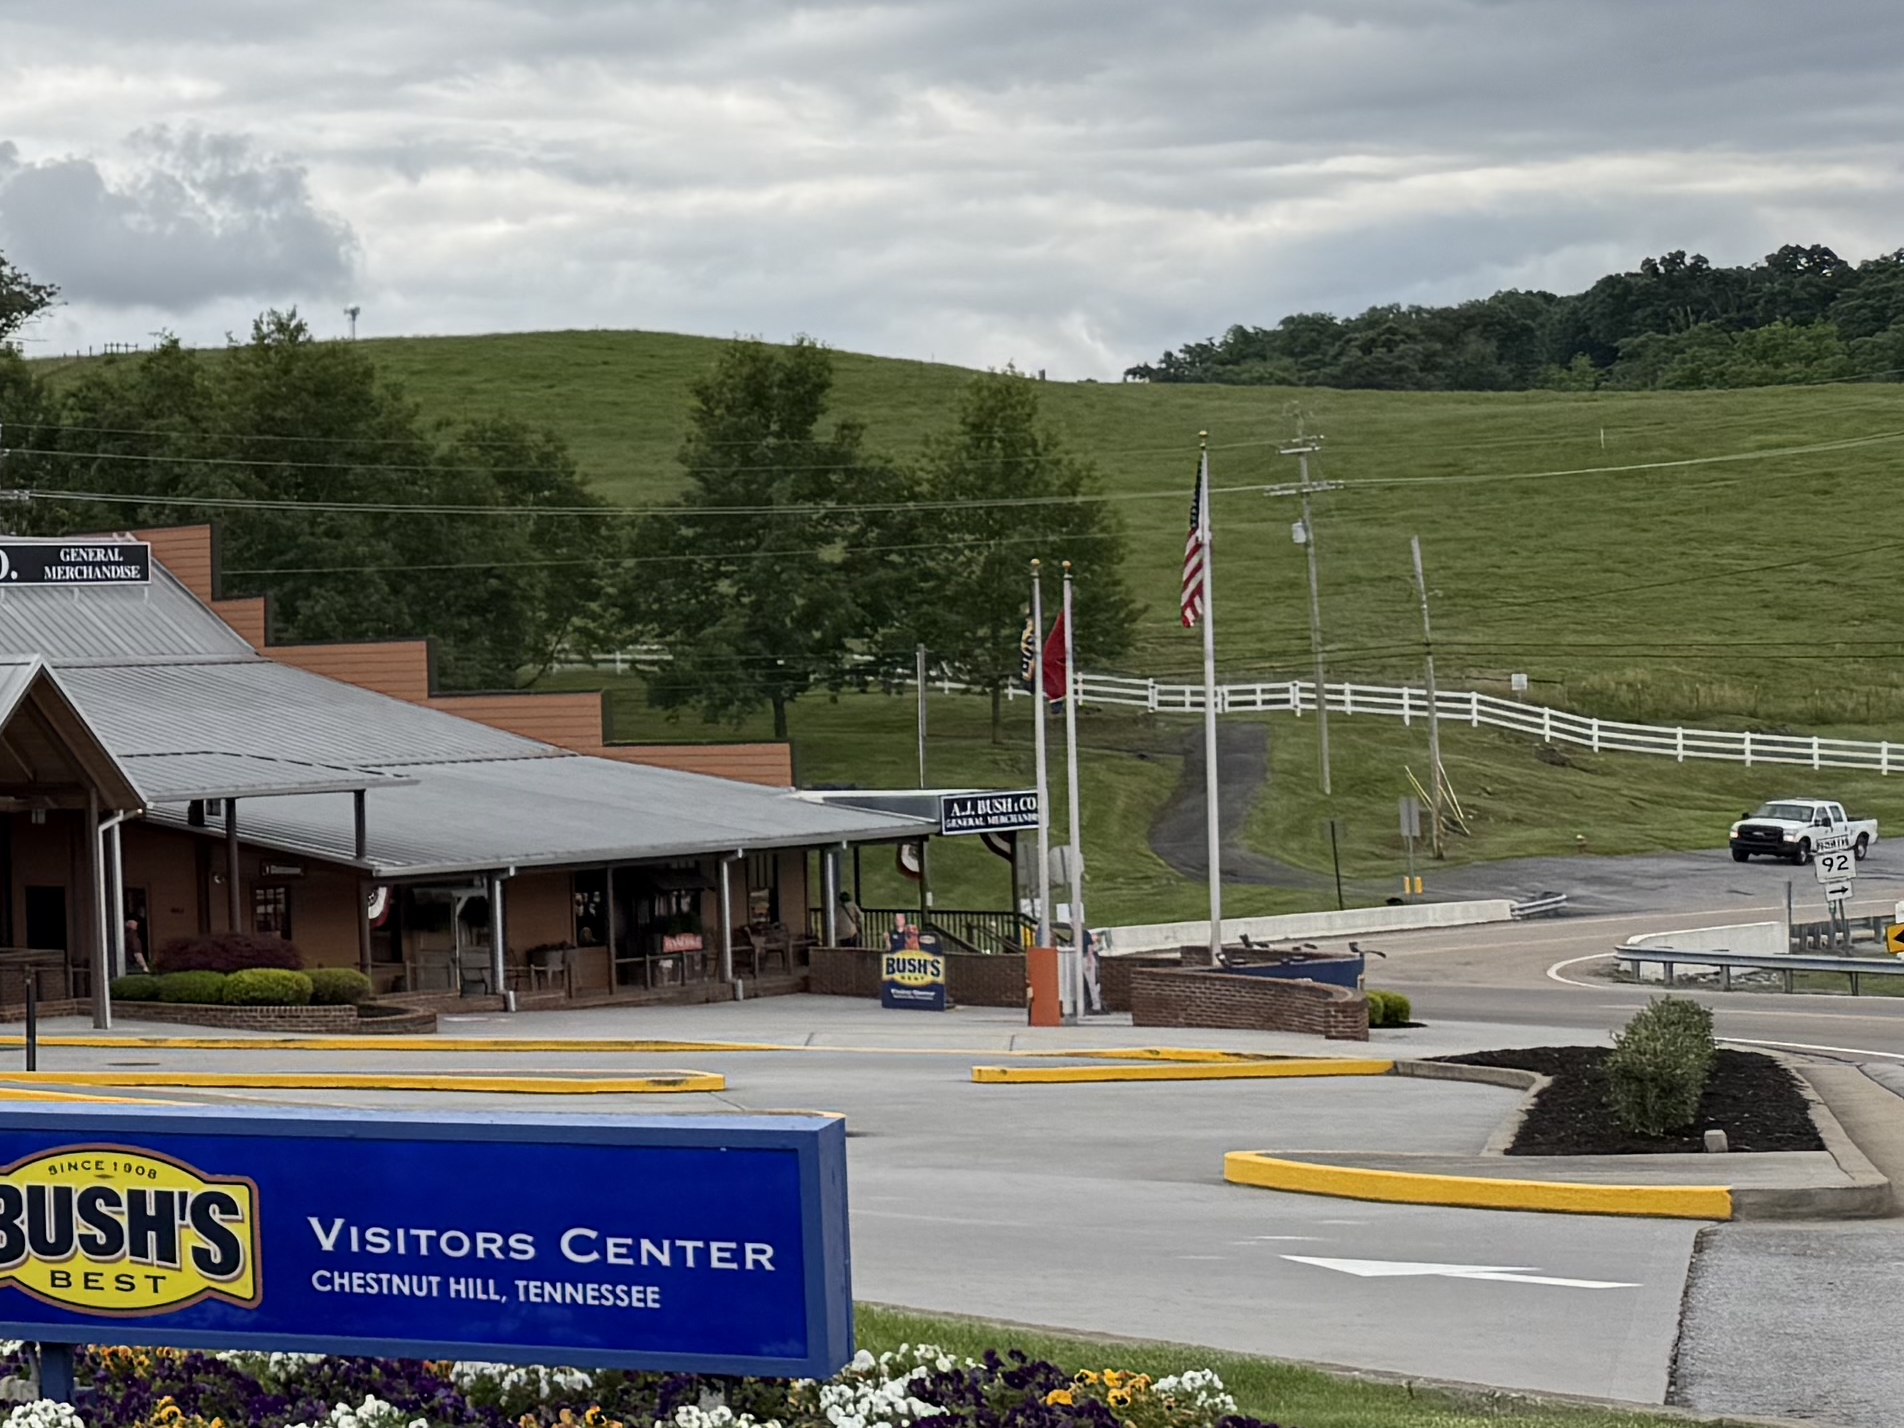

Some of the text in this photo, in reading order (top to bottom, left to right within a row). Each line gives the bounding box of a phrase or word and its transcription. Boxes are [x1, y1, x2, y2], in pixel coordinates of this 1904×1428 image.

[59, 548, 123, 562] GENERAL
[44, 564, 141, 580] MERCHANDISE
[950, 800, 975, 817] A.J.
[977, 797, 1012, 814] BUSH
[946, 816, 986, 828] GENERAL
[1822, 855, 1849, 872] 92
[885, 957, 941, 977] BUSH'S
[48, 1160, 158, 1179] SINCE 1908
[49, 1270, 167, 1294] BEST
[311, 1270, 661, 1309] CHESTNUT HILL, TENNESSEE
